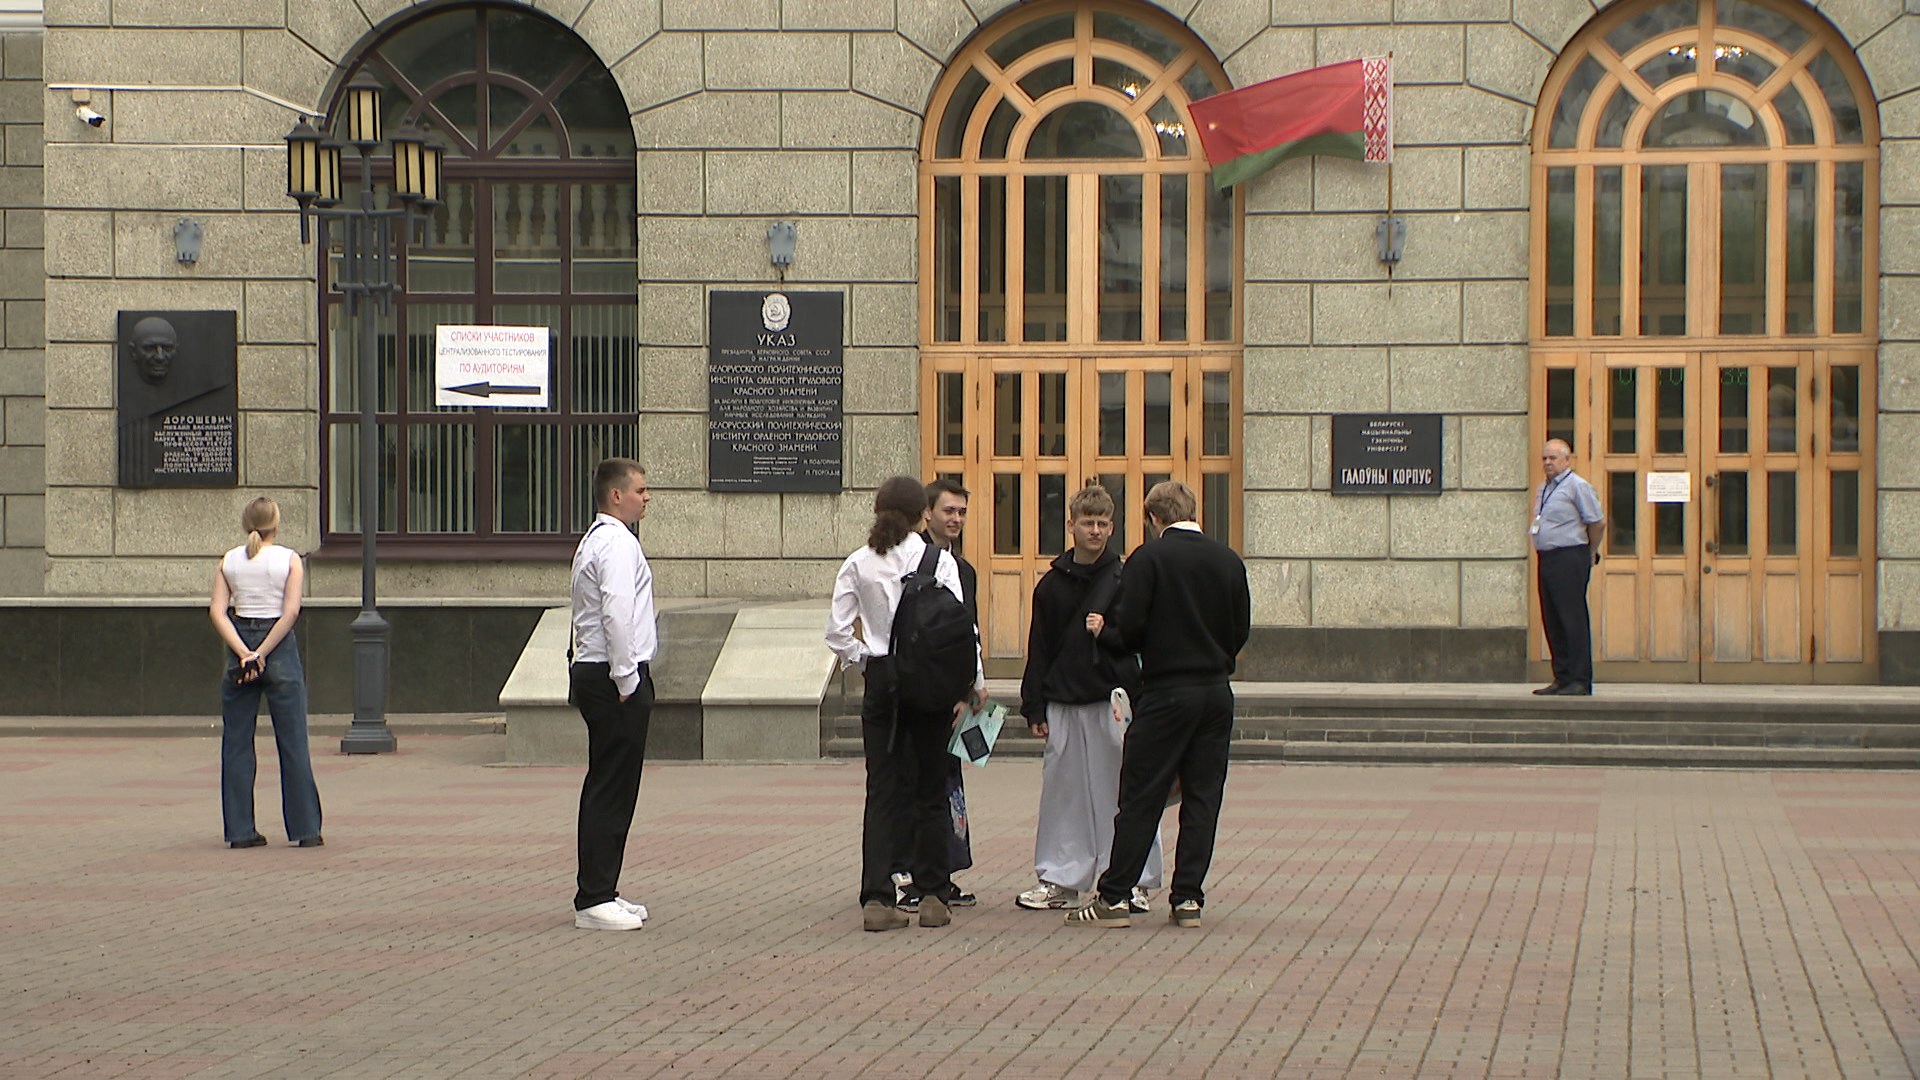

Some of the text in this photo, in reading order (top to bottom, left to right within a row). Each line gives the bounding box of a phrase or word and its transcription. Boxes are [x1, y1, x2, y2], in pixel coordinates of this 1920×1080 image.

[450, 331, 535, 342] СПИСКИ УЧАСТНИКОВ
[756, 334, 797, 346] УКАЗ
[438, 347, 547, 357] ЦЕНТРАЛИЗОВАННОГО ТЕСТИРОВАНИЯ
[459, 363, 525, 374] ПО АУДИТОРИЯМ
[709, 365, 842, 374] БЕЛОРУССКОГО ПОЛИТЕХНИЧЕСКОГО
[710, 376, 841, 385] ИНСТИТУТА ОРДЕНОМ ТРУДОВОГО
[733, 387, 818, 396] КРАСНОГО ЗНАМЕНИ
[163, 415, 232, 424] ДОРОШЕВИЧ
[709, 421, 842, 430] БЕЛОРУССКИЙ ПОЛИТЕХНИЧЕСКИЙ
[711, 432, 839, 441] ИНСТИТУТ ОРДЕНОМ ТРУДОВОГО
[732, 443, 775, 452] КРАСНОГО
[1341, 467, 1432, 484] ГАЛОЎНЫ КОРПУС
